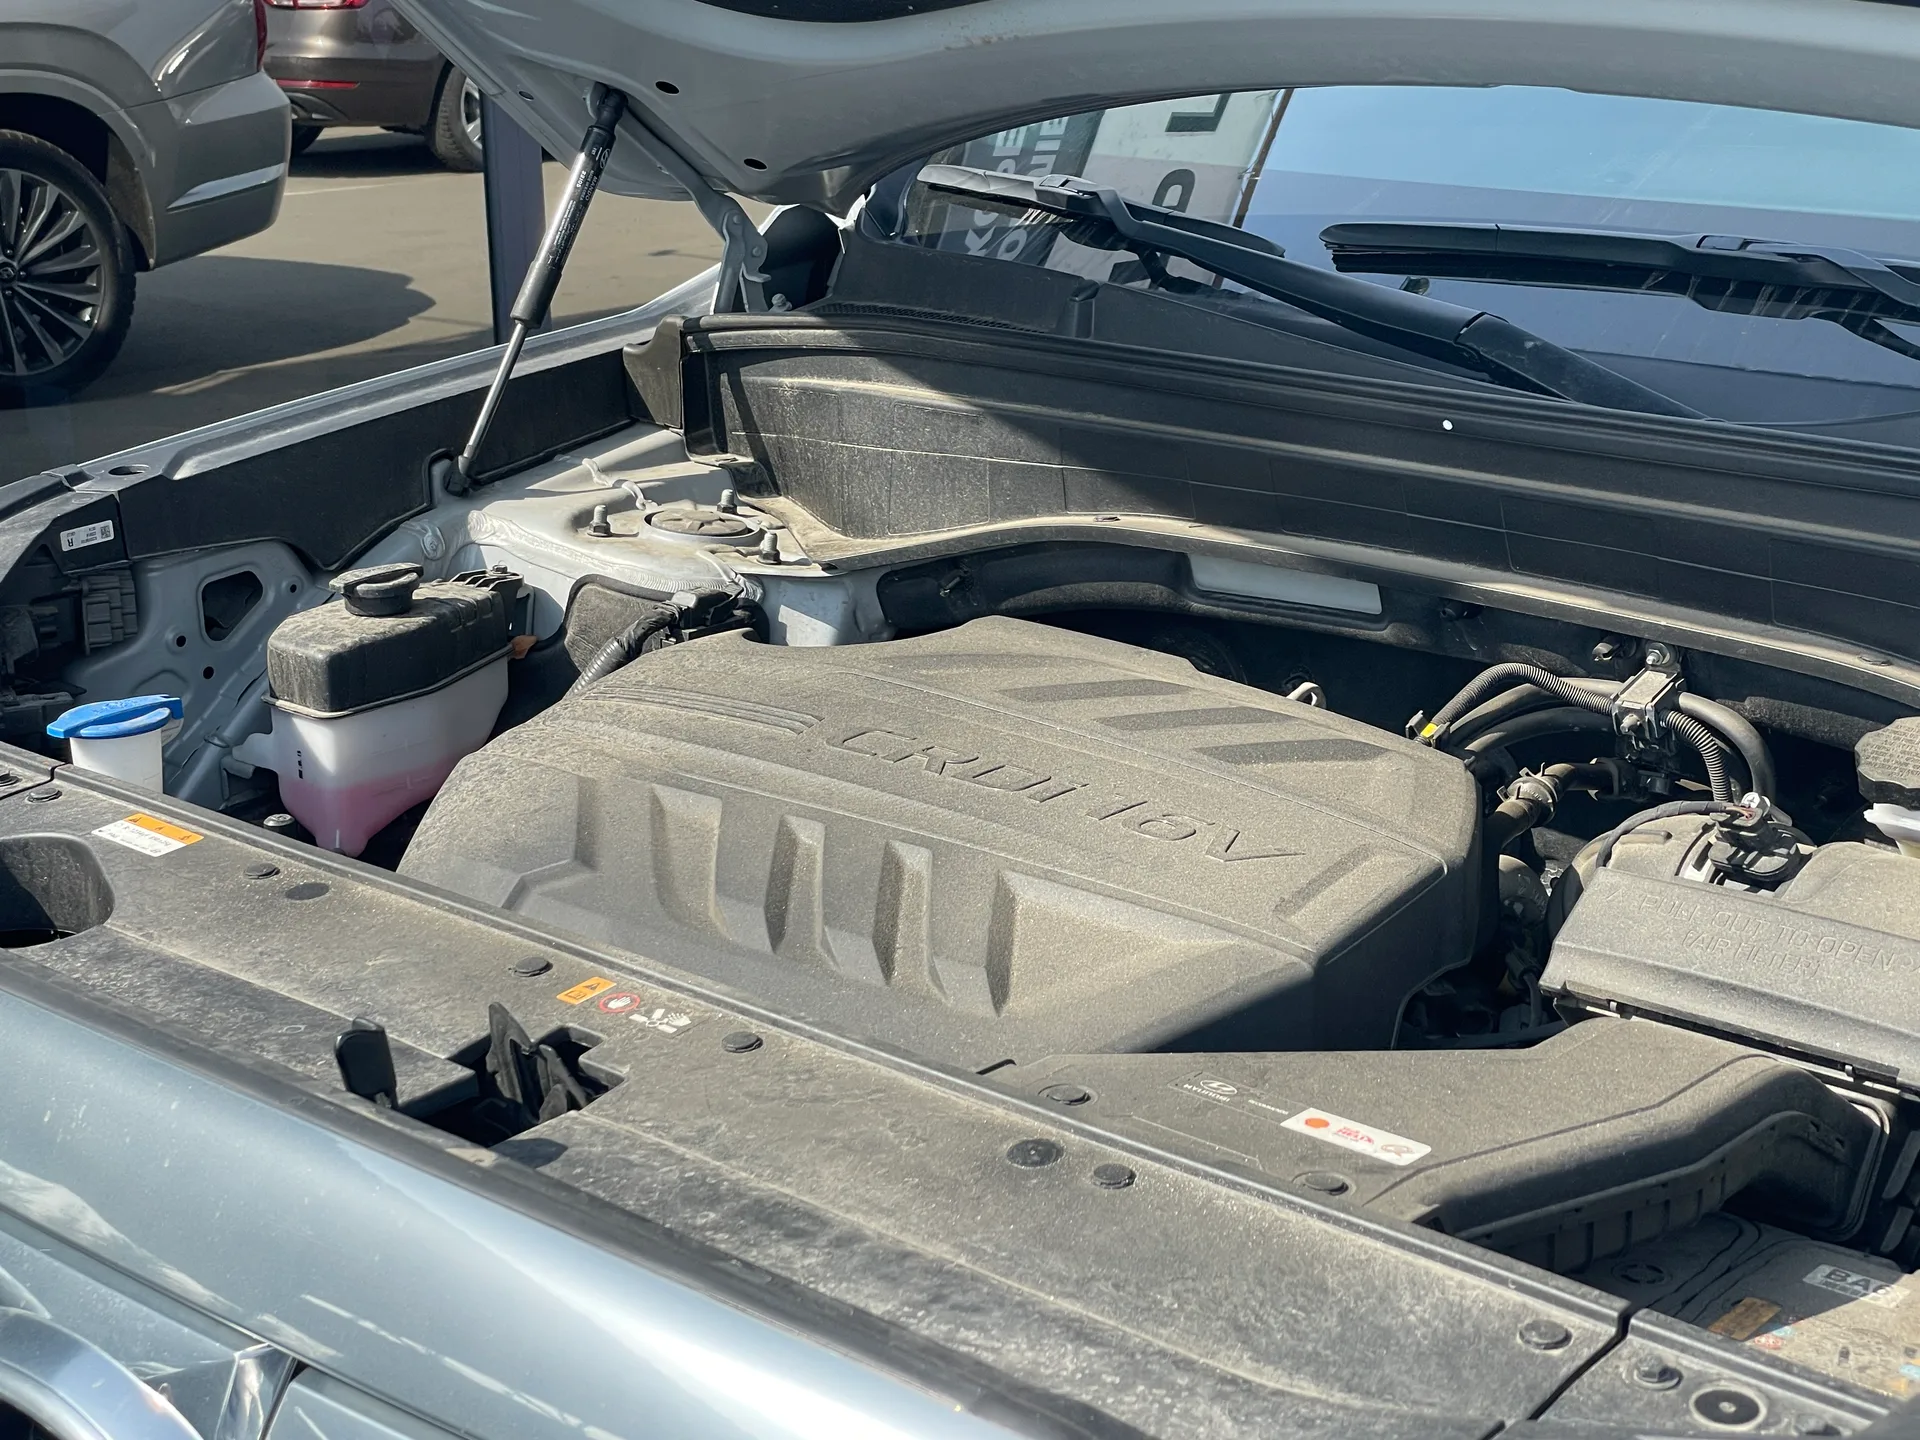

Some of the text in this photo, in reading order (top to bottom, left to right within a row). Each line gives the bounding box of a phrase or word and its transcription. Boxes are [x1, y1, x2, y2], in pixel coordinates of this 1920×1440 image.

[1085, 798, 1307, 862] 16V
[1816, 936, 1896, 971] OPEN
[1183, 1083, 1231, 1102] HYUNDAI
